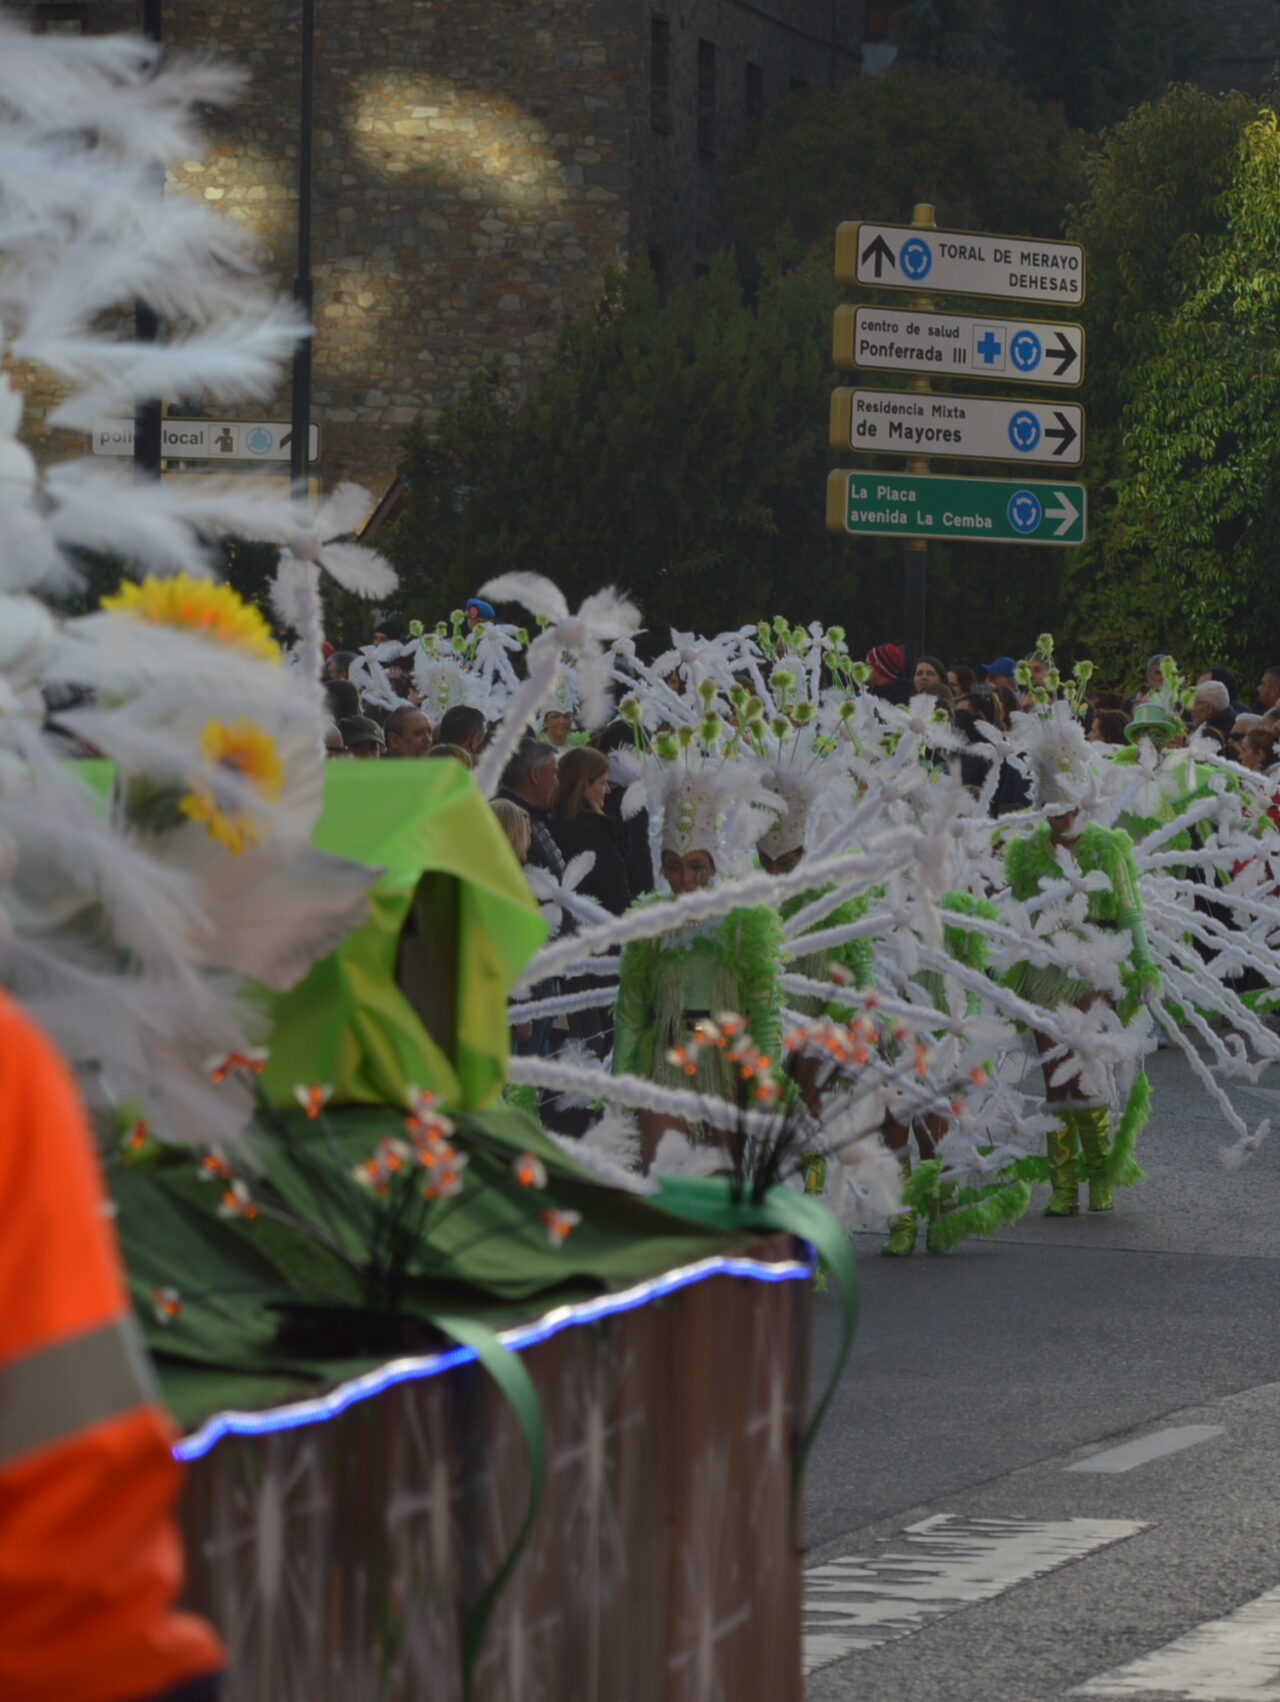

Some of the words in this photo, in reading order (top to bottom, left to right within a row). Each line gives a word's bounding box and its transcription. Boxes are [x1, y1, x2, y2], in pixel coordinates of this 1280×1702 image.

[939, 243, 985, 261] TORAL
[994, 249, 1012, 264] DE
[1020, 251, 1079, 270] MERAYO
[1009, 273, 1078, 292] DEHESAS
[861, 320, 899, 333] centro
[906, 323, 920, 335] de
[928, 325, 960, 338] salud
[860, 340, 943, 361] Ponferrada
[953, 348, 967, 364] III
[857, 399, 924, 416] Residencia
[931, 404, 966, 419] Mixta
[163, 430, 204, 445] local
[856, 419, 877, 436] de
[889, 421, 962, 444] Mayores
[851, 484, 868, 499] La
[877, 485, 917, 501] Placa
[851, 508, 908, 524] avenida
[917, 510, 933, 525] La
[942, 512, 992, 528] Cemba
